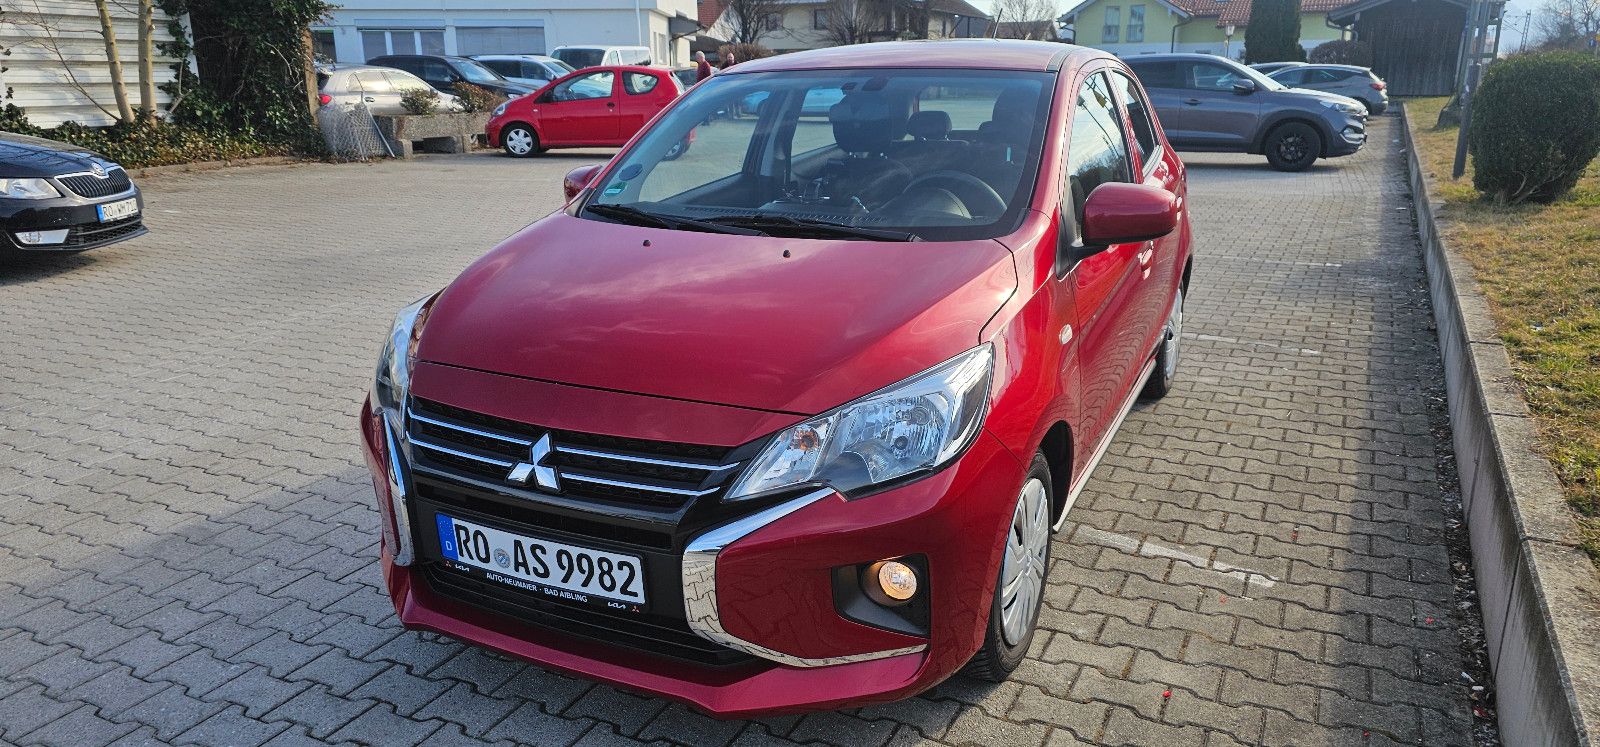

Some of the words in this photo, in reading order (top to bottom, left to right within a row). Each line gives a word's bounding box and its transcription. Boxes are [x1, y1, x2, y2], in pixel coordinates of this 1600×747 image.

[445, 540, 453, 551] D
[454, 523, 491, 564] RO
[513, 539, 550, 579] AS
[555, 548, 639, 598] 9982
[486, 572, 538, 592] AUTO-NEUMAIER
[544, 587, 558, 597] BAD
[559, 590, 588, 603] AIBLING
